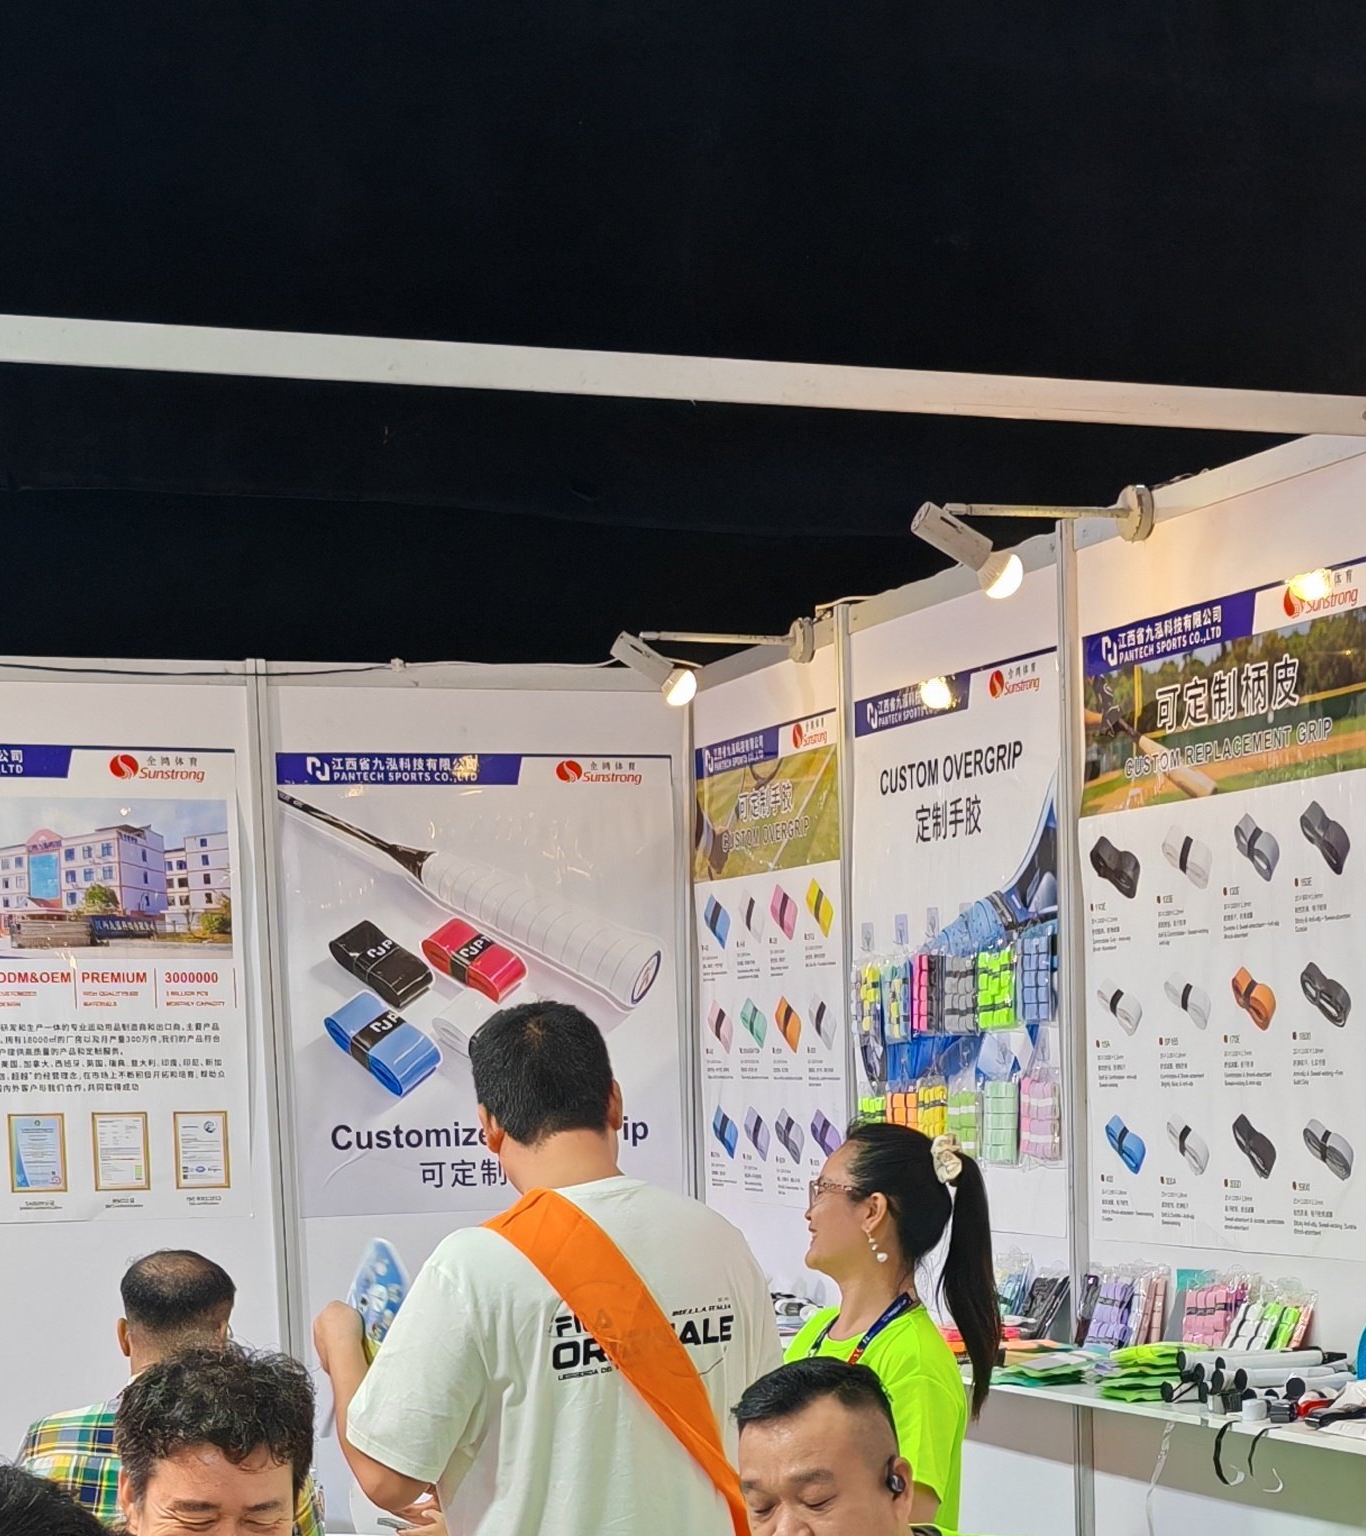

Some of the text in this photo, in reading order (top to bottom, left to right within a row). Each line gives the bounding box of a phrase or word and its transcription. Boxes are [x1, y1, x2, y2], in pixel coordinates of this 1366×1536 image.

[1118, 605, 1222, 650] 江西省九泓科技有限公司
[1119, 643, 1154, 665] PANTECH
[1156, 634, 1187, 655] SPORTS
[1155, 654, 1299, 734] 可定制柄皮
[1124, 717, 1333, 780] CUSTOM REPLACEMENT GRIP
[139, 767, 205, 783] Sunstrong
[334, 772, 385, 782] PANTECH
[388, 772, 431, 782] SPORTS
[582, 771, 642, 786] Sunstrong
[880, 740, 1023, 796] CUSTOM OVERGRIP
[762, 815, 811, 846] OVERGRIP
[915, 794, 982, 844] 定制手胶
[82, 972, 148, 983] PREMIUM
[165, 972, 218, 983] 3000000
[623, 1116, 649, 1142] ip
